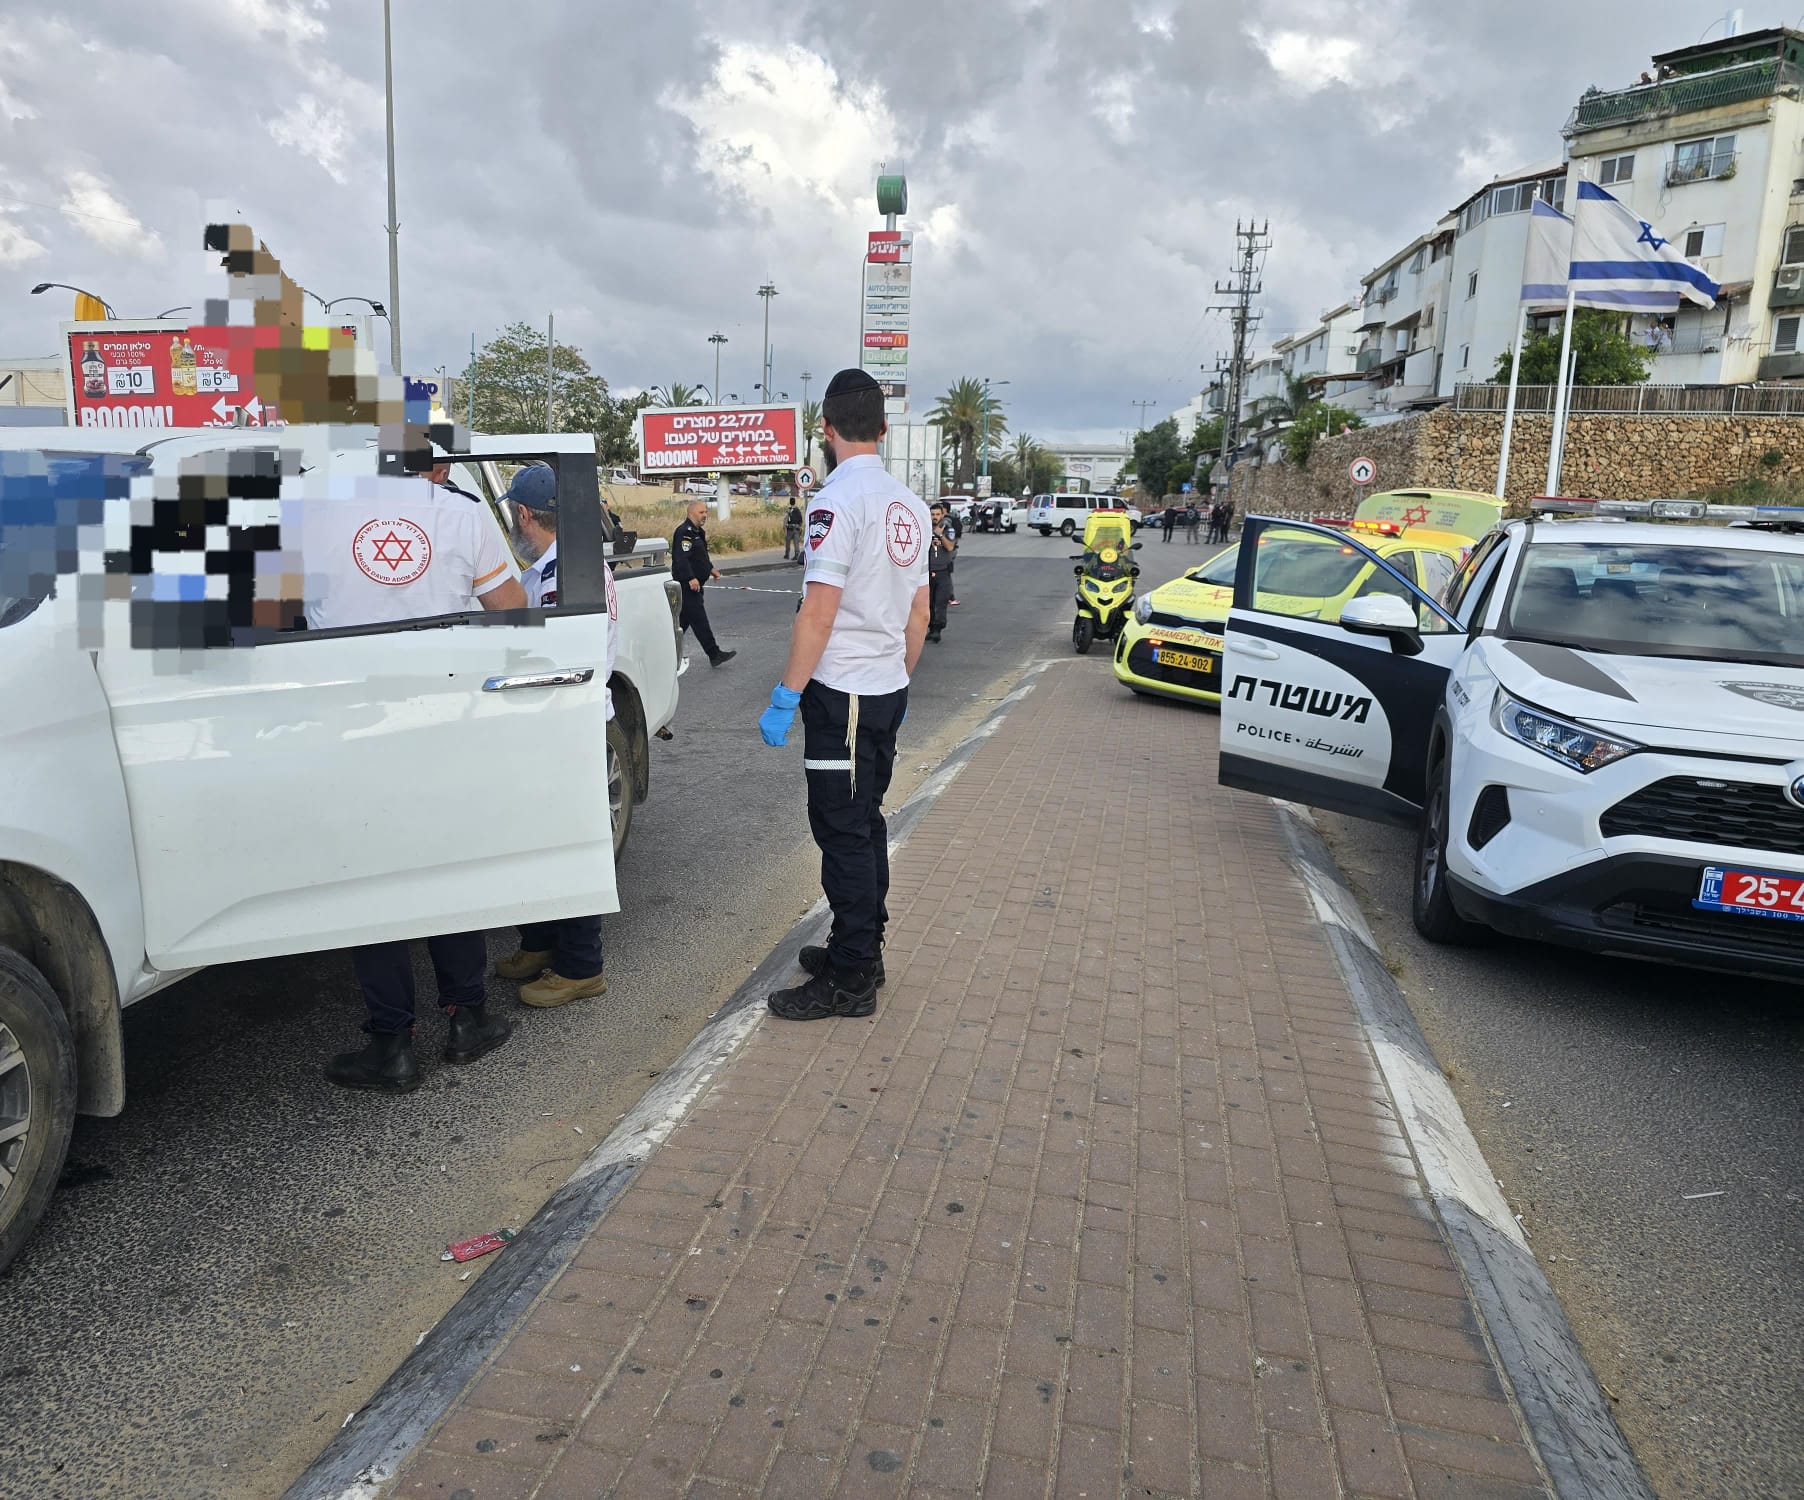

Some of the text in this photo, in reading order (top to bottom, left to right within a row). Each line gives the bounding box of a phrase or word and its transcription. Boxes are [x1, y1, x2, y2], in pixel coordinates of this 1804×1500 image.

[103, 342, 151, 351] סילאן תמרים
[866, 351, 892, 361] Delta
[81, 405, 173, 427] BOOOM!
[673, 413, 765, 429] 22,777 מוצרים
[664, 429, 775, 445] במחירים של פעם!
[647, 449, 698, 467] BOOOM!
[406, 524, 417, 533] דוד
[356, 552, 373, 573] MAGEN
[370, 570, 391, 582] DAVID
[392, 574, 412, 582] ADOM
[416, 553, 428, 575] ISRAEL
[1149, 627, 1193, 642] PARAMEDIC
[1227, 674, 1373, 724] משטרת
[1236, 723, 1293, 743] POLICE
[1305, 738, 1364, 758] الشرطة
[1706, 879, 1718, 894] IL
[1736, 907, 1767, 917] בשבילך
[1772, 911, 1788, 919] 100
